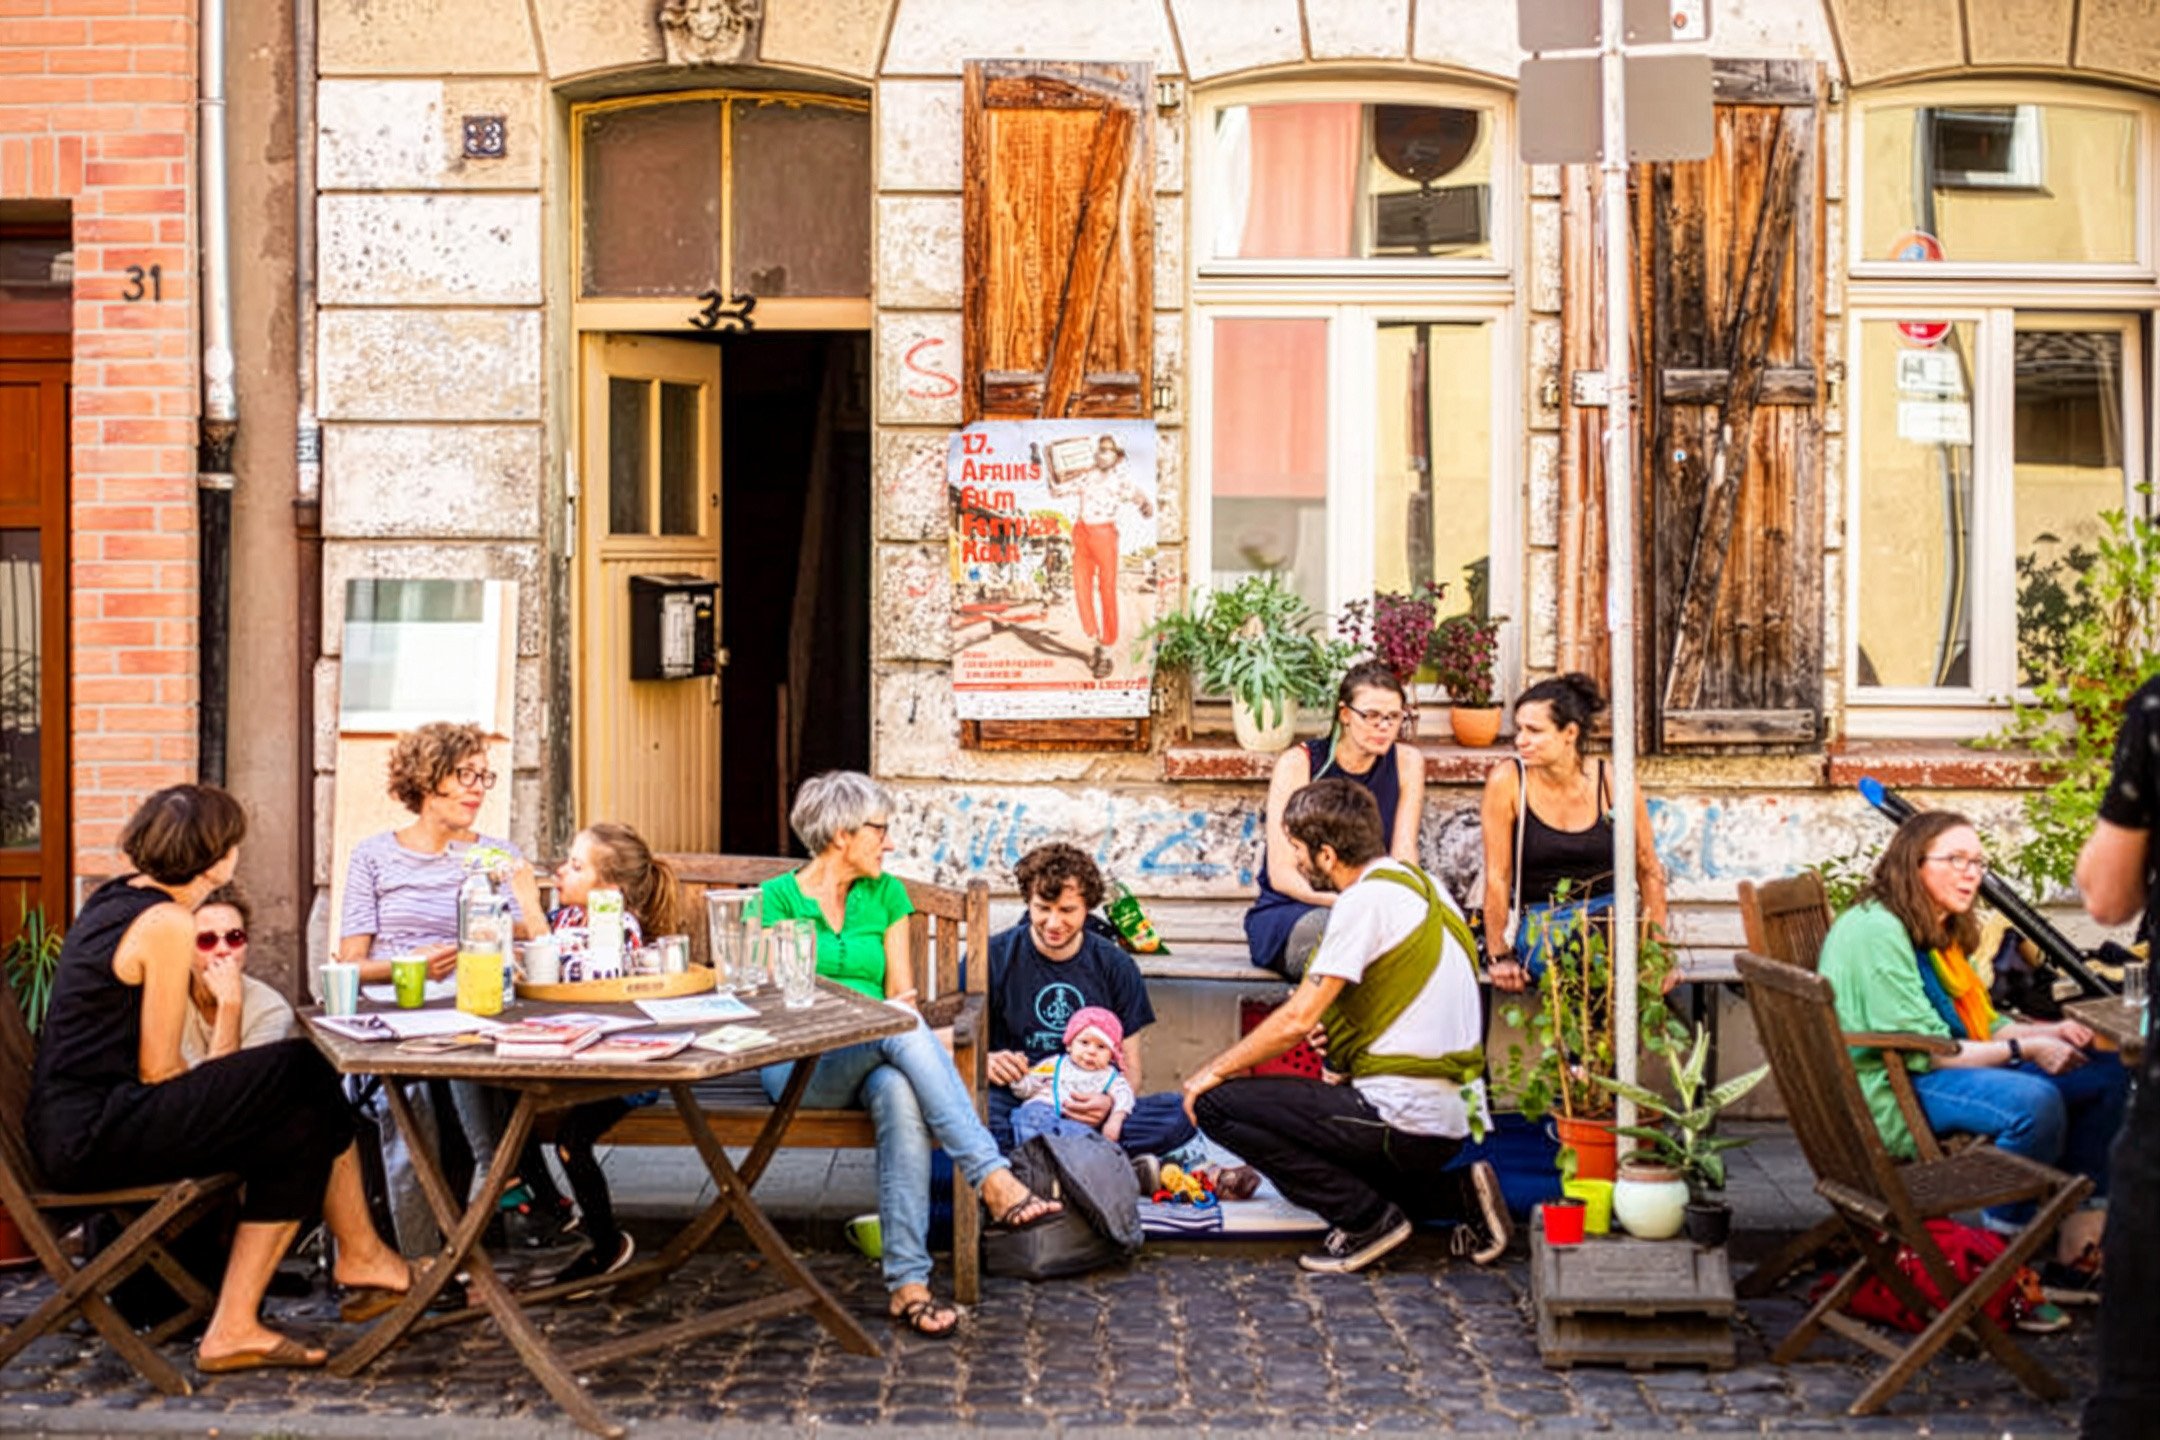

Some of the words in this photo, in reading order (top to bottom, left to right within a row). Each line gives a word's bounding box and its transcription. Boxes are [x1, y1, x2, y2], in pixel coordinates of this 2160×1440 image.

[123, 264, 161, 301] 31
[688, 288, 756, 334] 33
[904, 337, 961, 399] S
[961, 433, 993, 455] 17.
